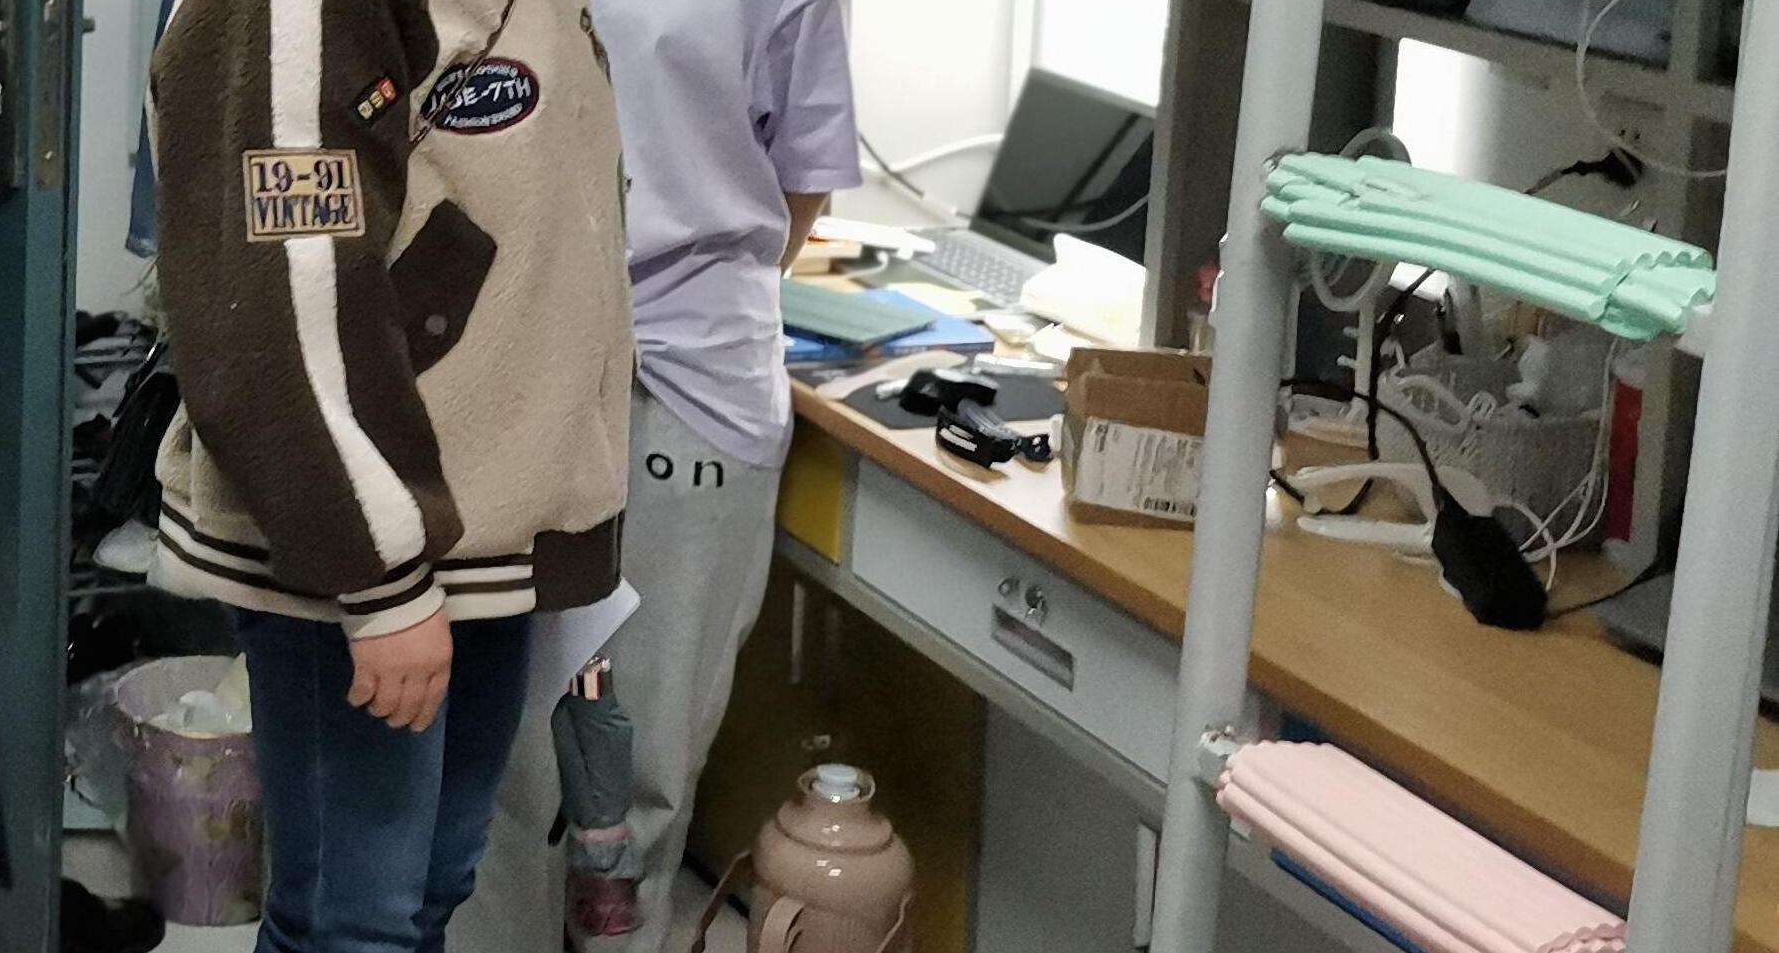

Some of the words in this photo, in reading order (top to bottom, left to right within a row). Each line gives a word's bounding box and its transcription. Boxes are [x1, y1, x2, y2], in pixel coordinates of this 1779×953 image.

[251, 159, 349, 193] 19-91
[255, 193, 354, 229] VINTAGE
[645, 453, 724, 488] on
